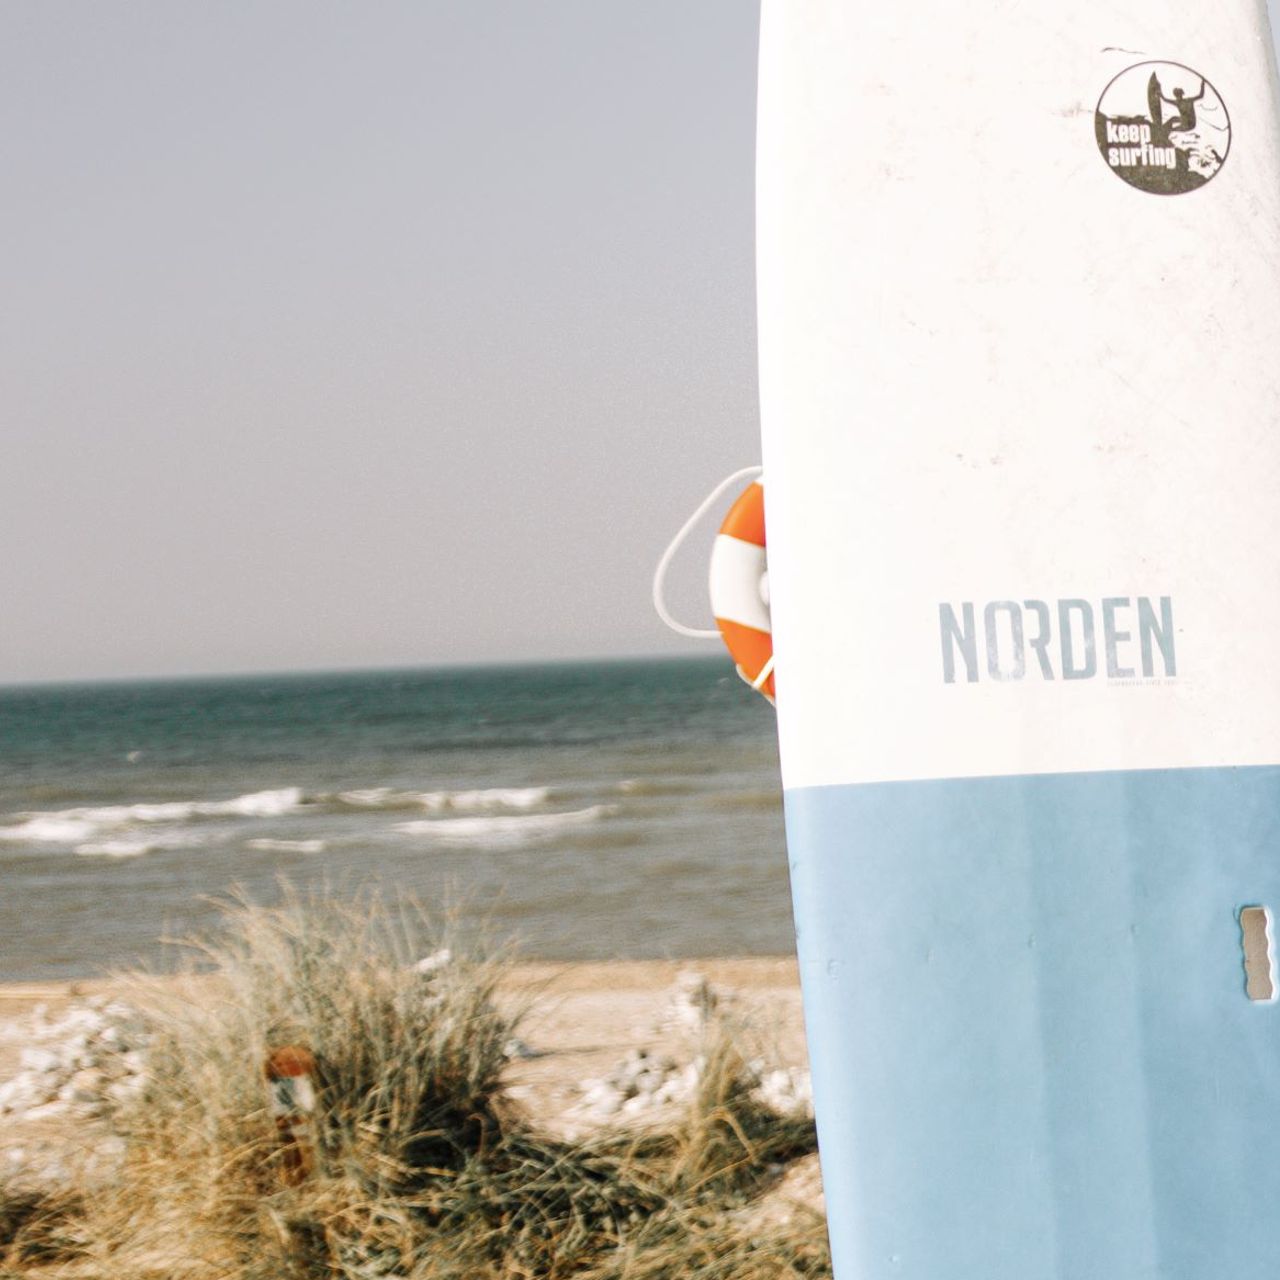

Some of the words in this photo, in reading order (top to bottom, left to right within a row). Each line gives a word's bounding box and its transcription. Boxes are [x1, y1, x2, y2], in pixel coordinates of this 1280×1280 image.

[1106, 120, 1151, 146] keep
[1108, 144, 1177, 170] surfing
[939, 596, 1177, 684] NORDEN
